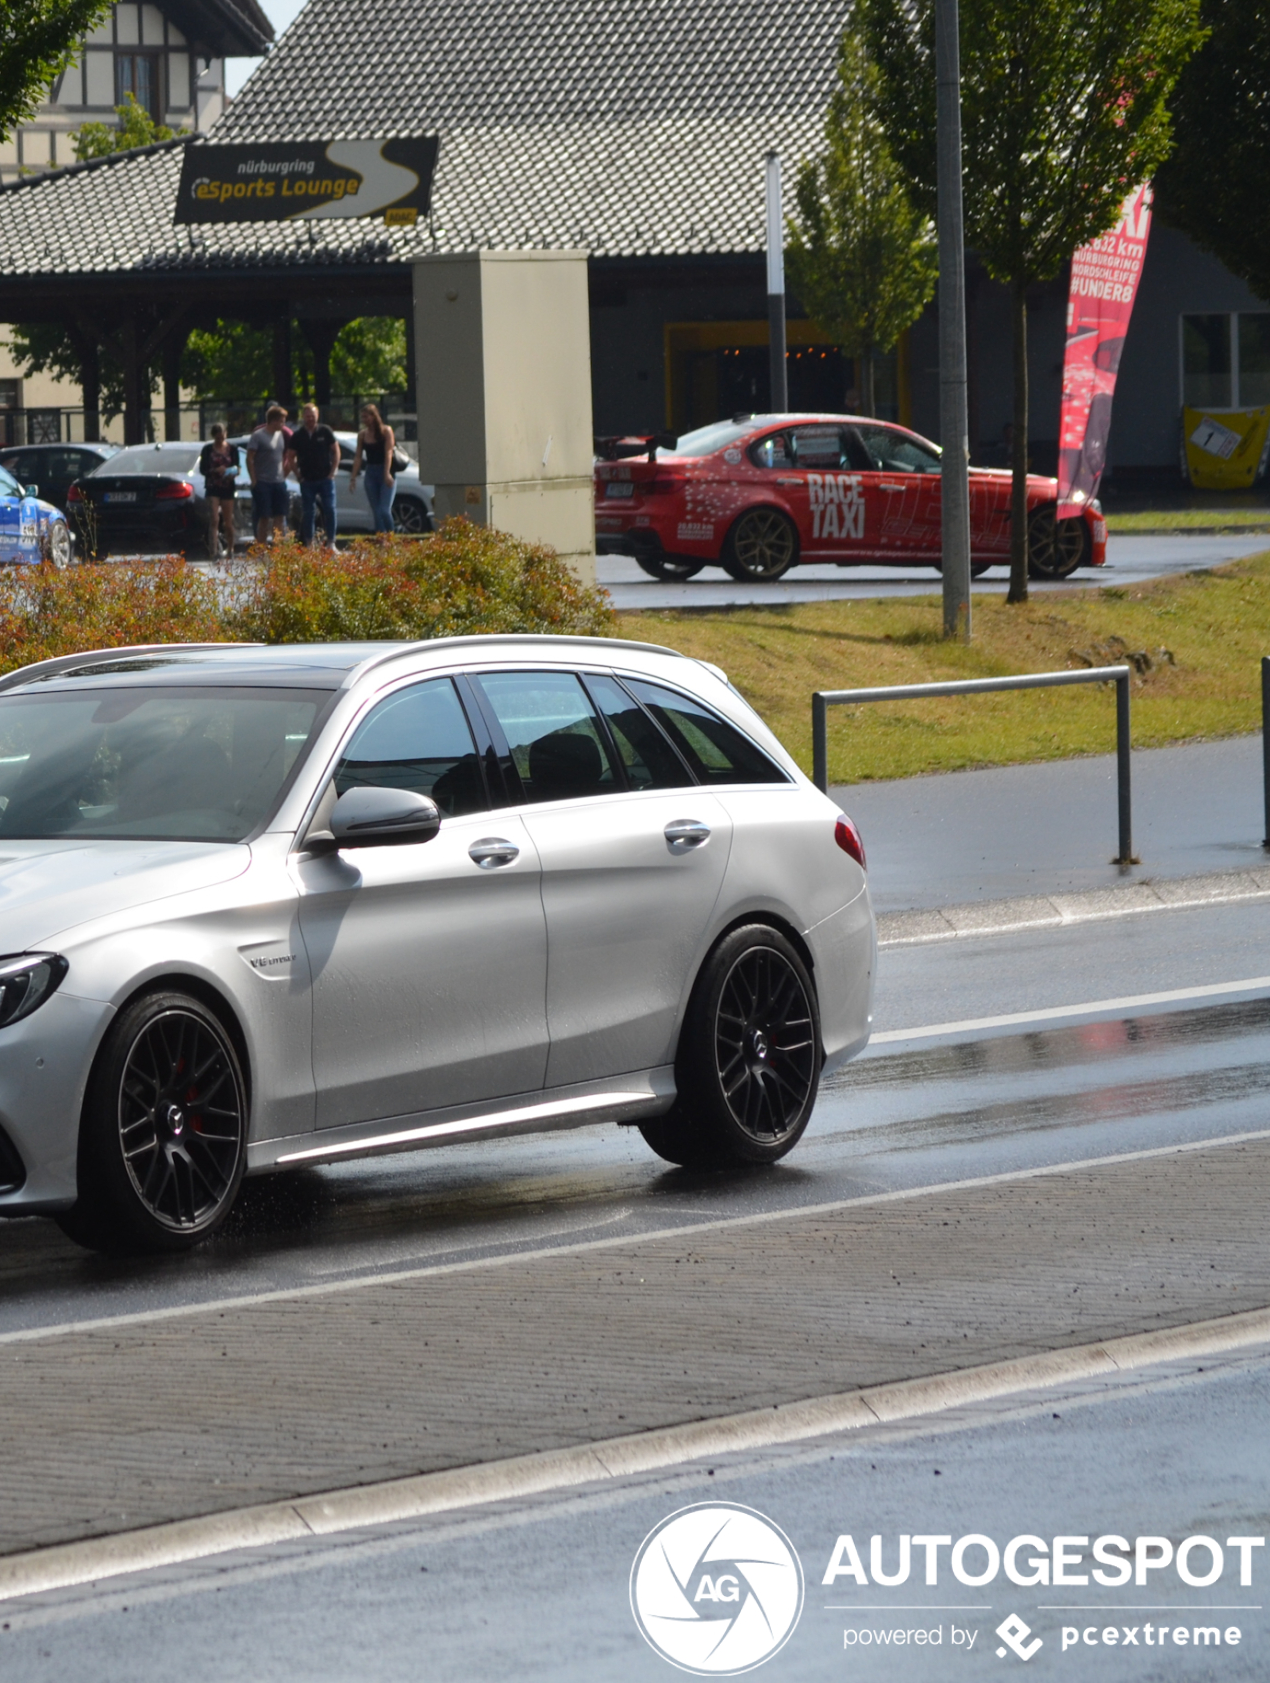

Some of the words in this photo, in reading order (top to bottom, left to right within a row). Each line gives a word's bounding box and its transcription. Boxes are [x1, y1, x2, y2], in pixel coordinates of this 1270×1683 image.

[237, 159, 315, 175] nürburgring
[196, 178, 276, 203] eSports
[281, 177, 359, 199] Lounge
[1117, 237, 1144, 259] km
[1071, 263, 1137, 285] NORDSCHLEIFE
[1070, 276, 1134, 304] #UNDER8
[807, 473, 865, 504] RACE
[810, 503, 866, 539] TAXI
